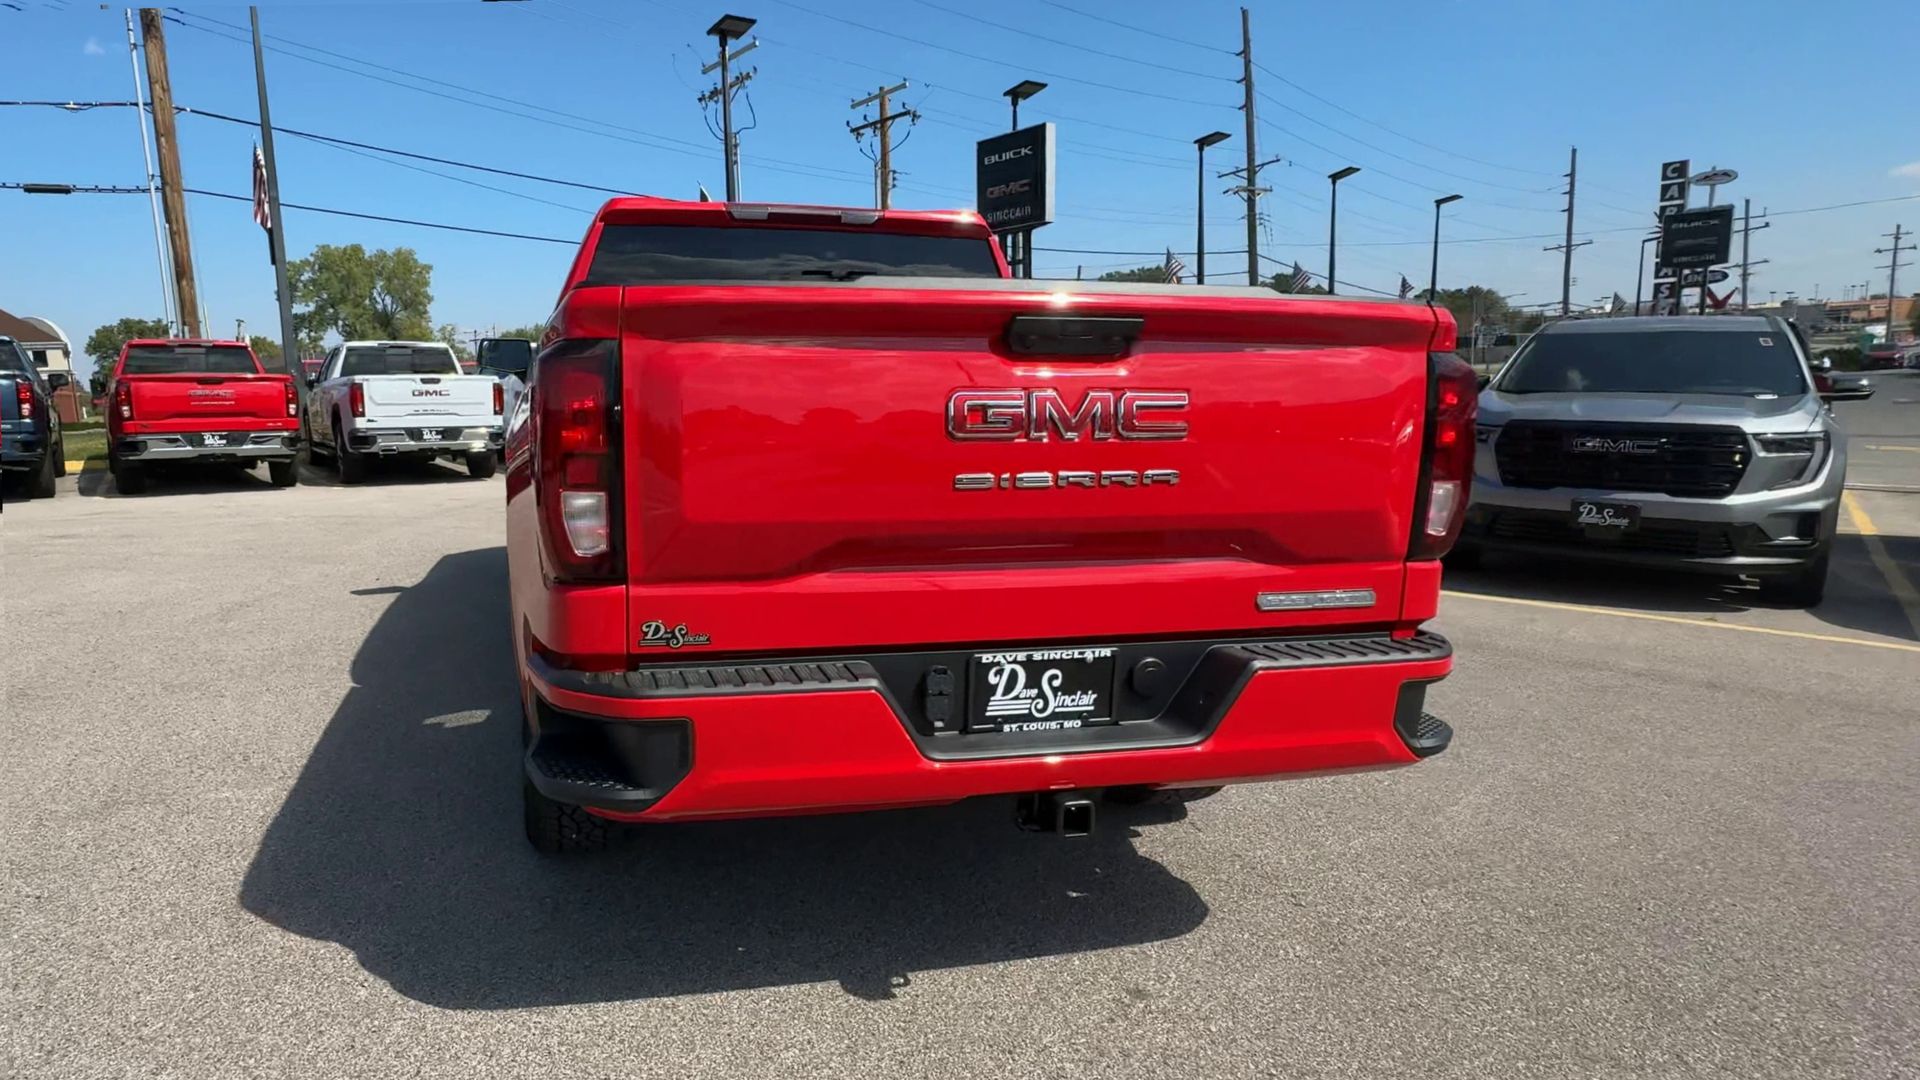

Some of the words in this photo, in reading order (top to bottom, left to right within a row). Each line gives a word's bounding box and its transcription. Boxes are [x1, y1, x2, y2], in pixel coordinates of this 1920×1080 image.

[984, 145, 1033, 165] BUICK
[986, 179, 1032, 198] GMC
[987, 206, 1031, 223] SINCLAIR
[412, 389, 451, 397] GMC
[946, 388, 1190, 442] GMC
[1572, 437, 1660, 454] GMC
[953, 469, 1182, 492] SIERRA
[669, 625, 709, 648] Sinclair
[981, 653, 1027, 664] DAVE
[1031, 650, 1112, 661] SINCLAIR
[988, 663, 1039, 701] Dave
[1031, 668, 1098, 718] Sinclair
[1003, 724, 1020, 733] ST.
[1063, 719, 1082, 729] MO
